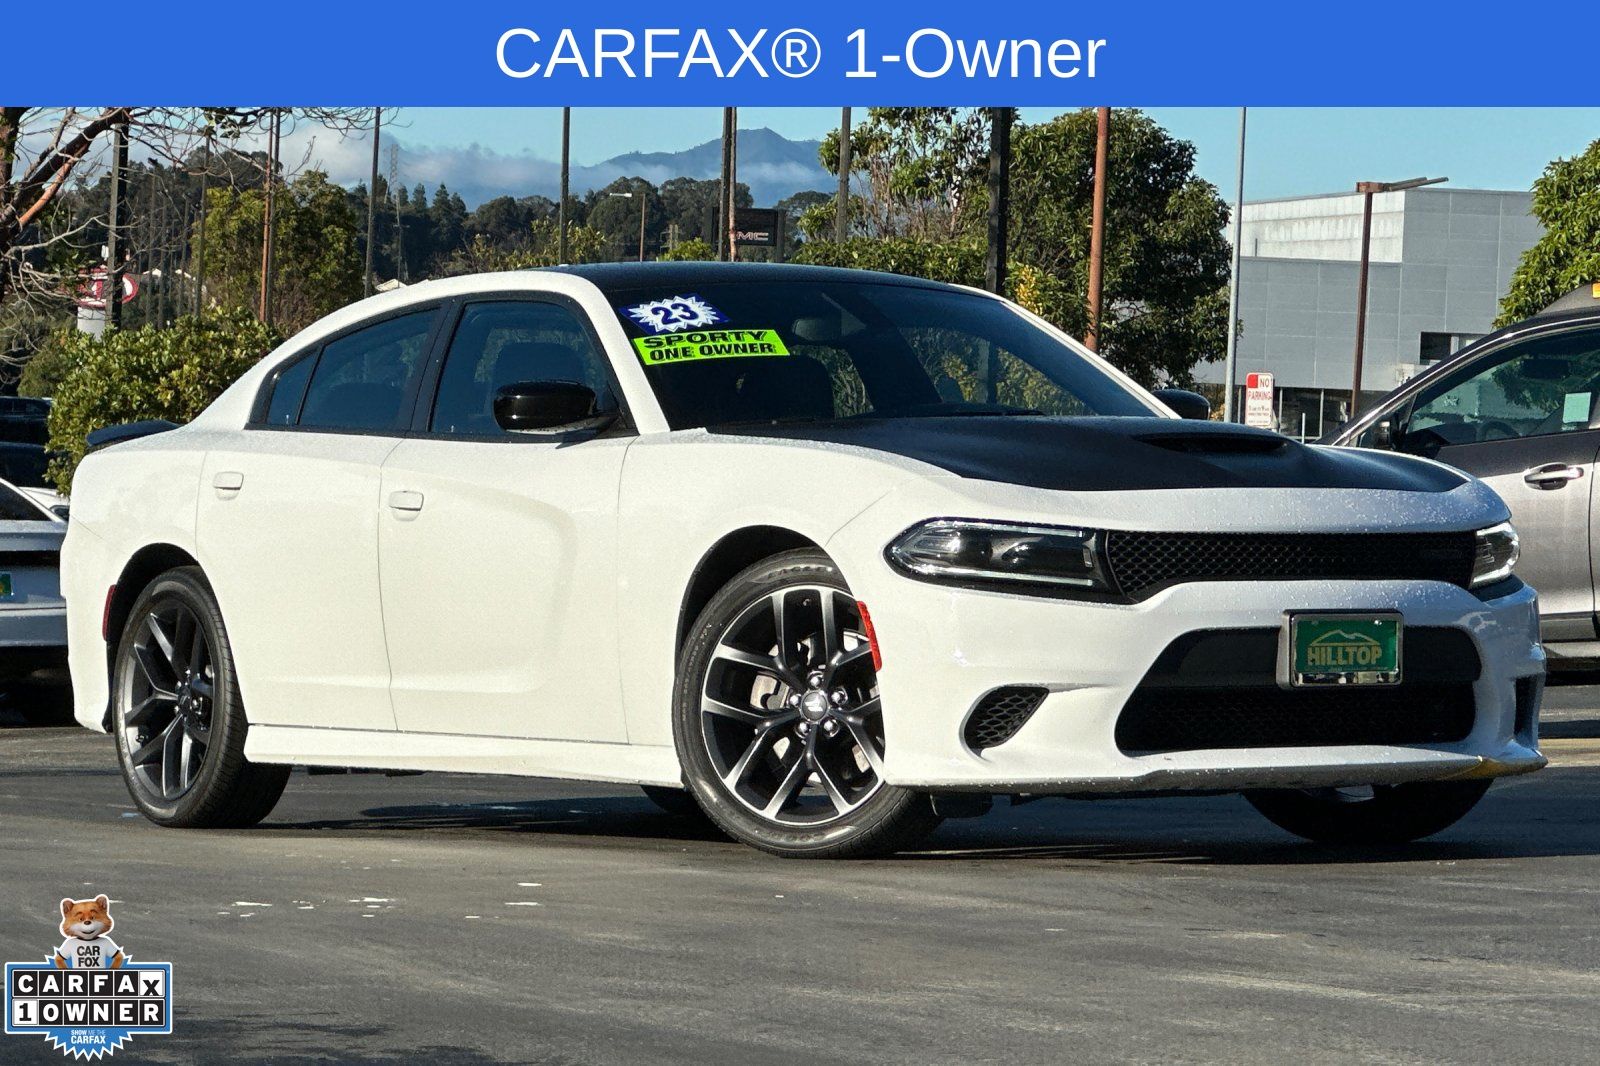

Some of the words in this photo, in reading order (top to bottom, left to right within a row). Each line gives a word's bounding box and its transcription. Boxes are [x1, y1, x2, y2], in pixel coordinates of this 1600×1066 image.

[651, 303, 699, 325] 23
[643, 331, 768, 348] SPORTY
[650, 346, 694, 361] ONE
[699, 343, 776, 356] OWNER
[1259, 378, 1270, 388] NO
[1307, 645, 1382, 666] HILLTOP
